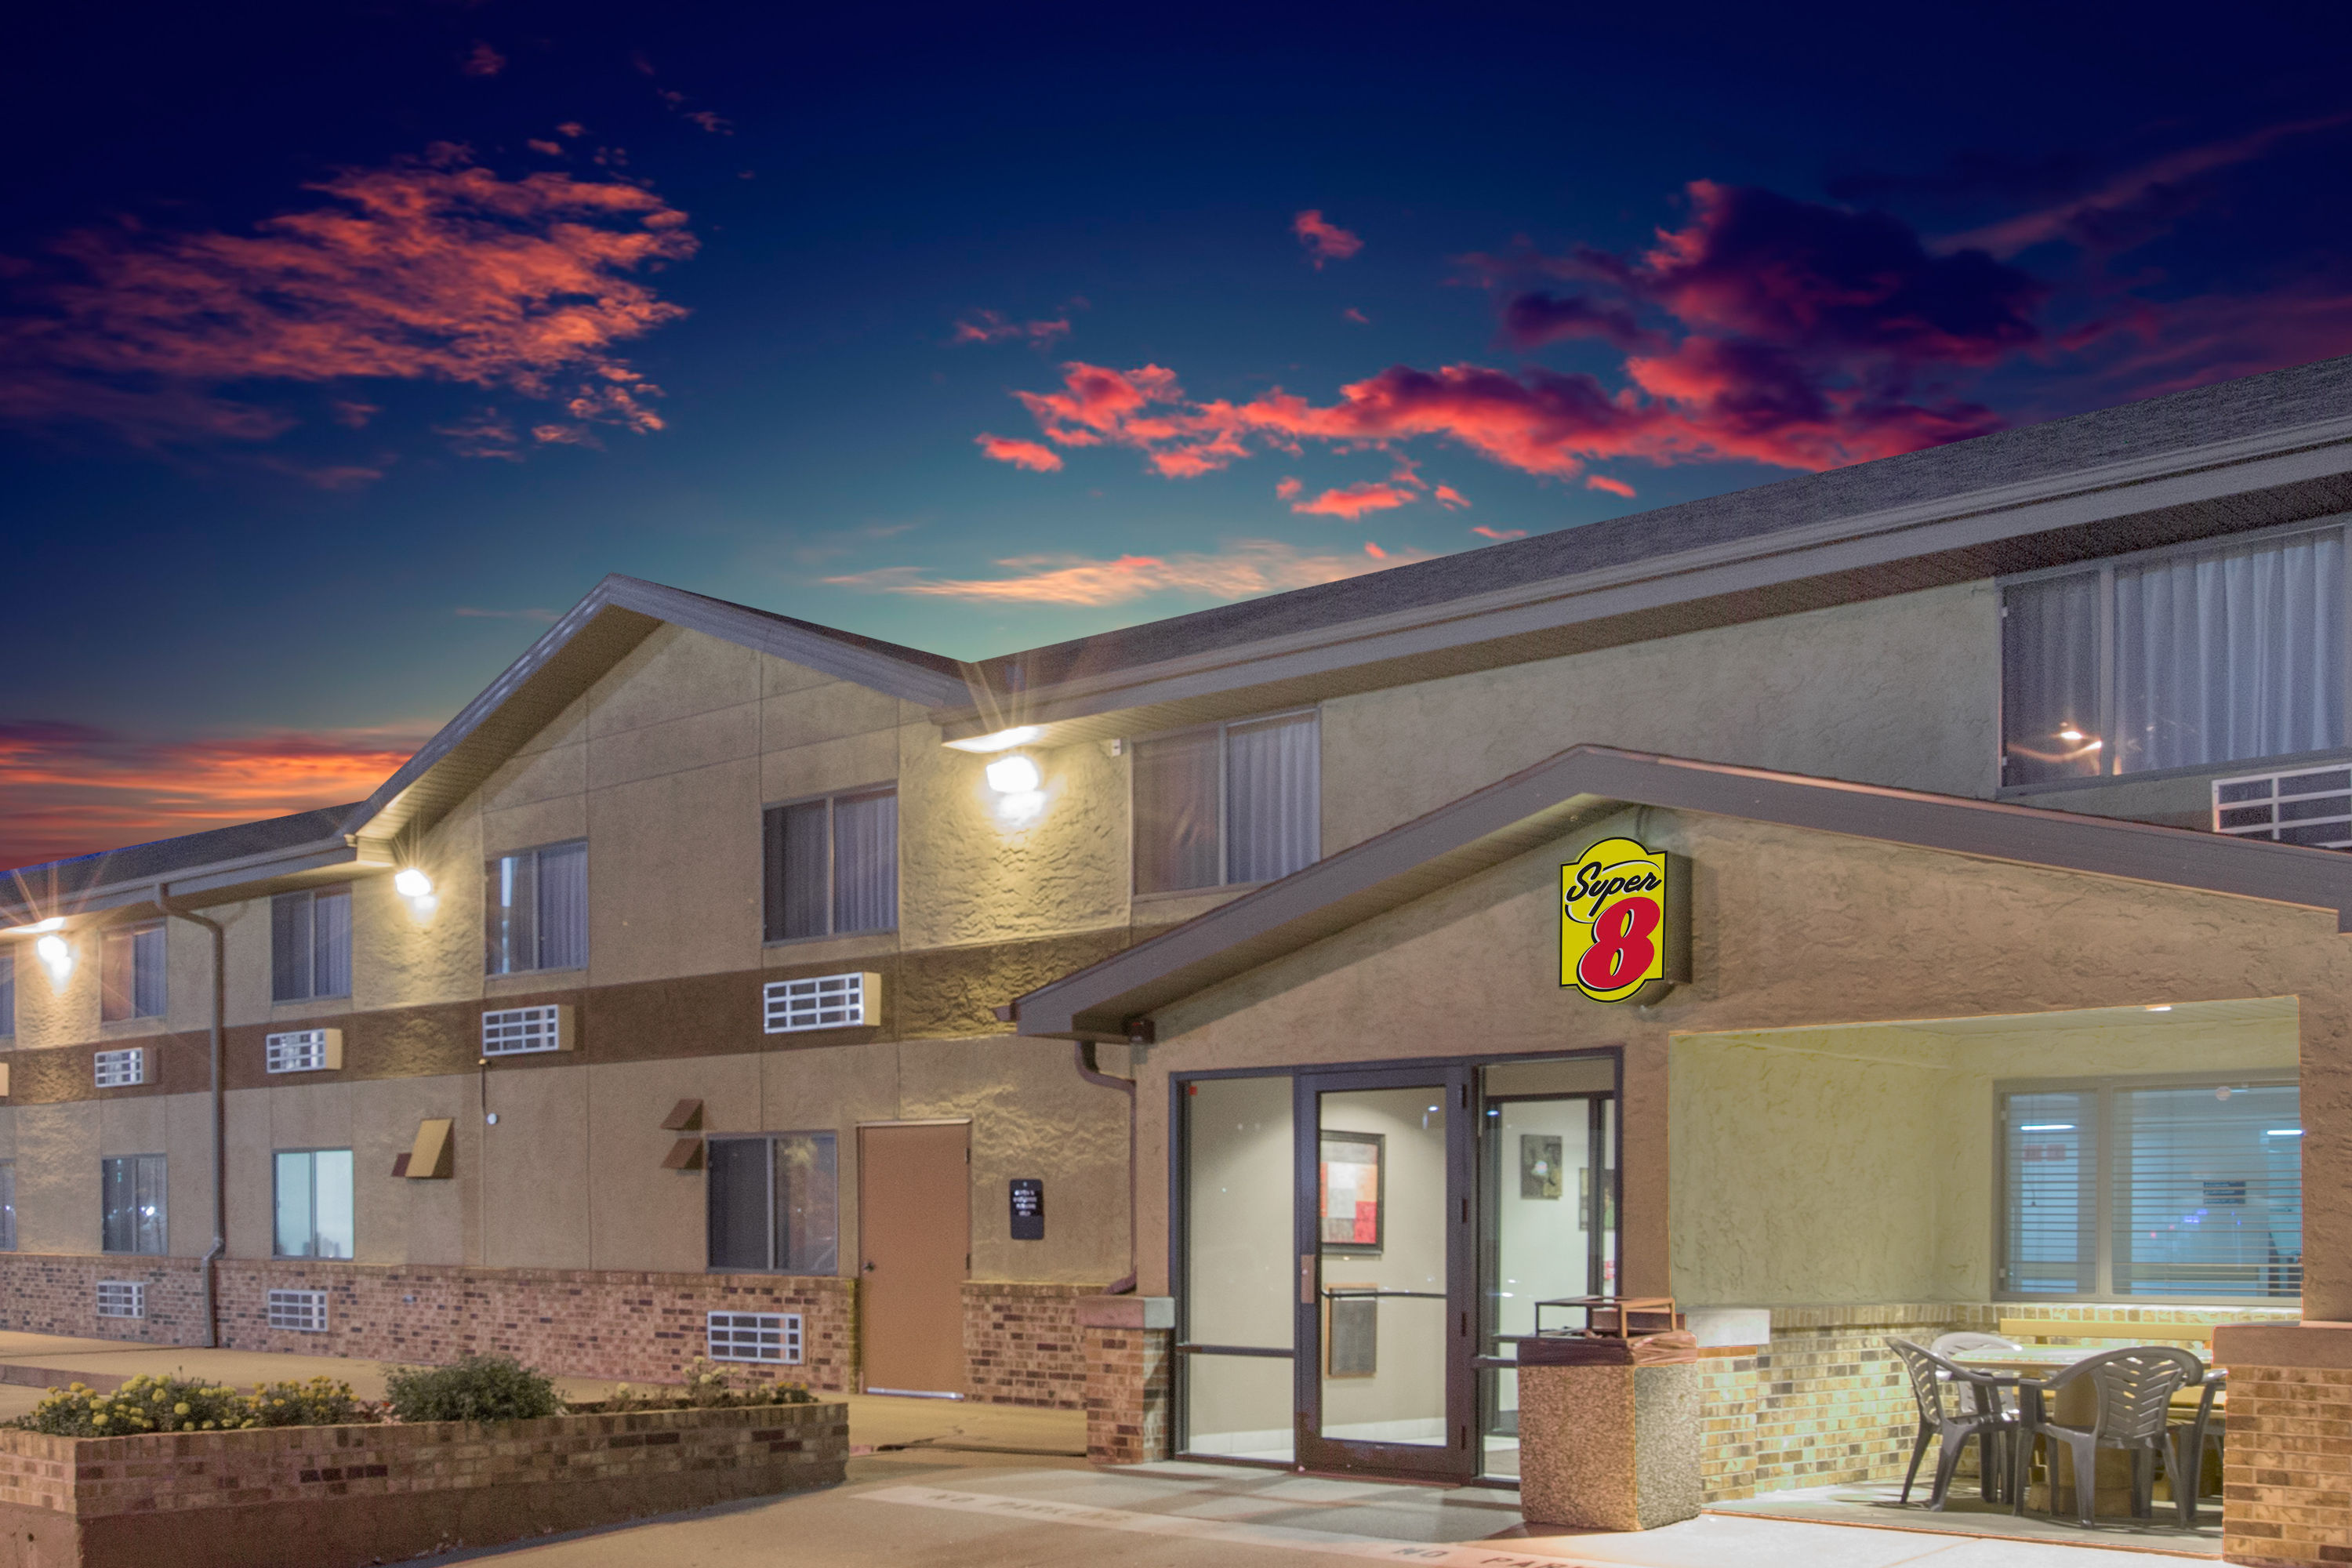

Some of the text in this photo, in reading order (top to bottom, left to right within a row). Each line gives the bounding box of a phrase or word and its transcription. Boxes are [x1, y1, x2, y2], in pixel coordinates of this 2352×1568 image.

[1566, 861, 1662, 917] Super
[1577, 896, 1661, 992] 8
[926, 1493, 976, 1503] NO
[1392, 1547, 1450, 1558] NO
